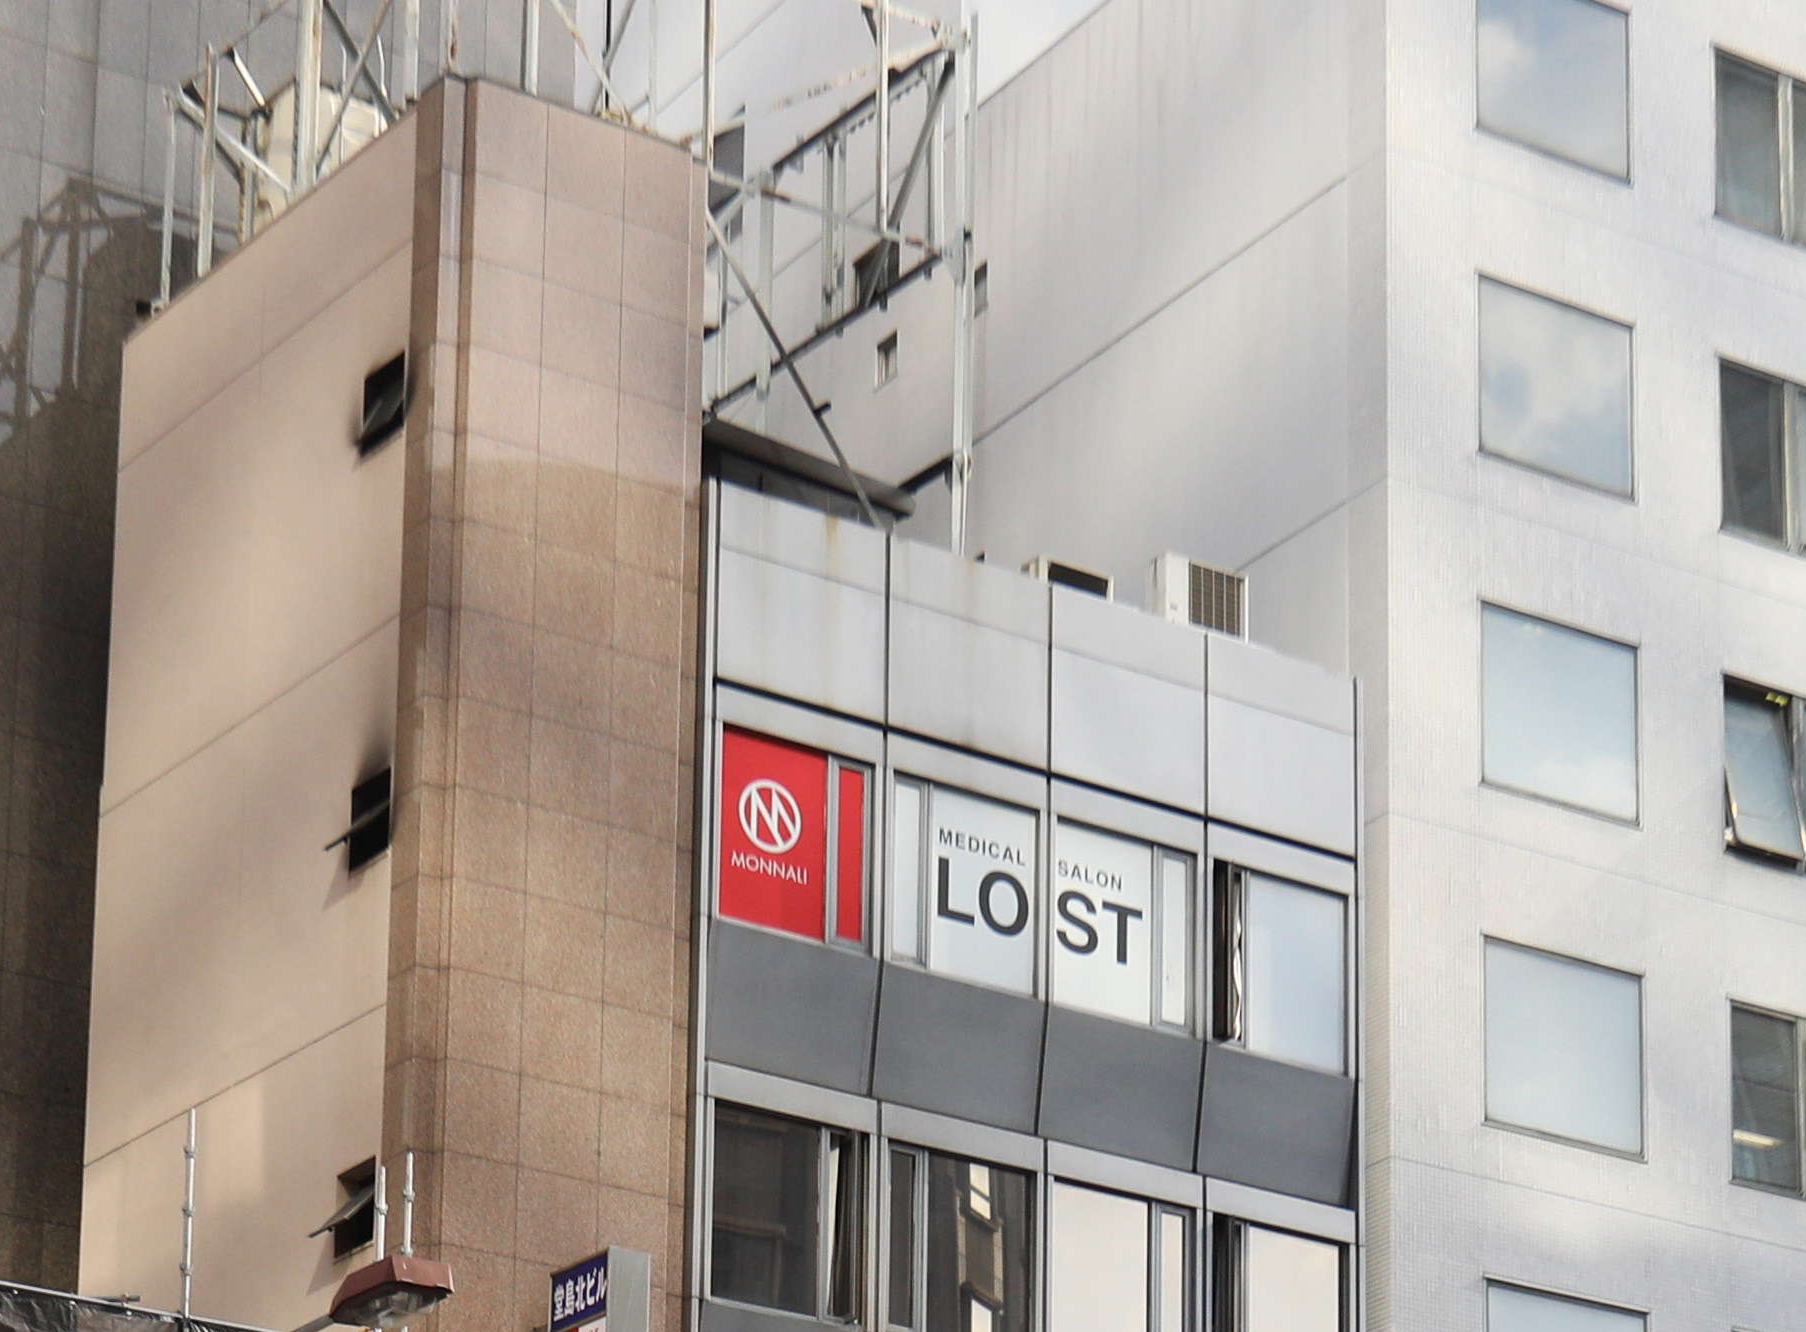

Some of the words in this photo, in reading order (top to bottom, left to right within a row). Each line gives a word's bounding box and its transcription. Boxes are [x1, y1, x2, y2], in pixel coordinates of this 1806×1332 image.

[731, 851, 808, 885] MONNALI
[938, 826, 1026, 869] MEDICAL
[1057, 860, 1124, 892] SALON
[553, 1266, 608, 1321] 堂島北ビル
